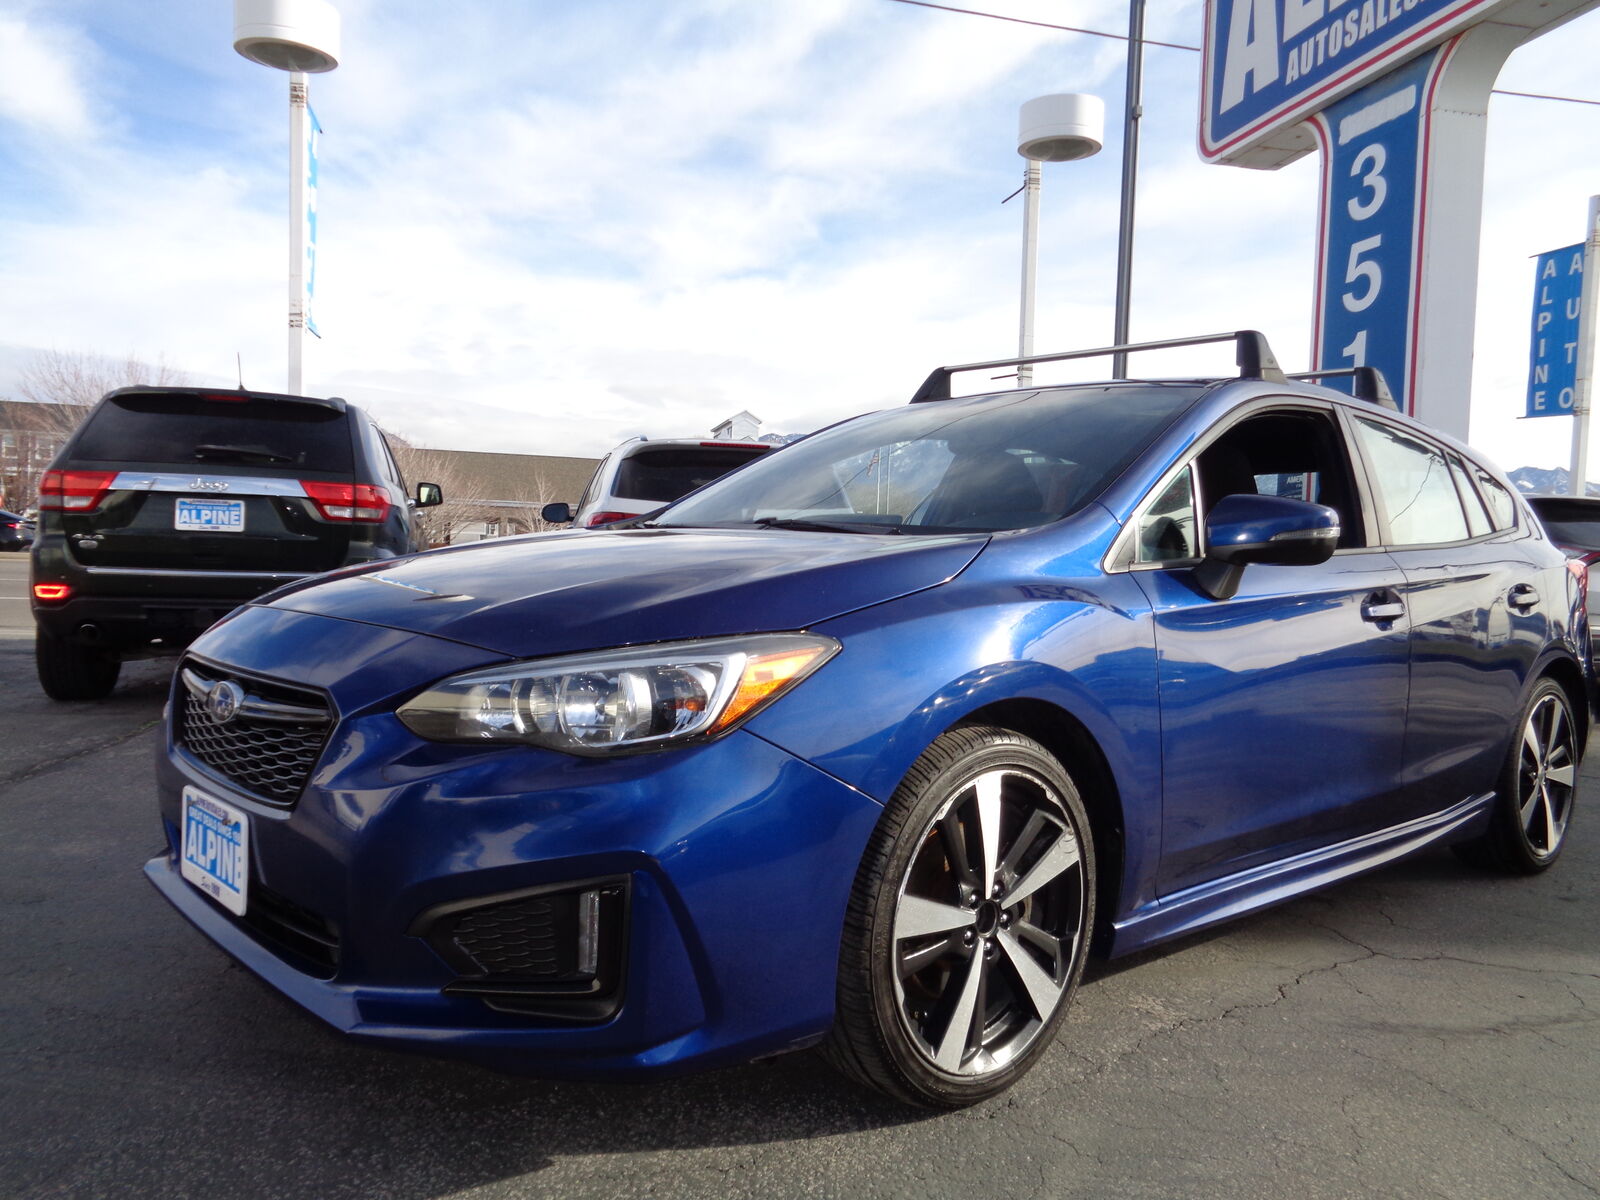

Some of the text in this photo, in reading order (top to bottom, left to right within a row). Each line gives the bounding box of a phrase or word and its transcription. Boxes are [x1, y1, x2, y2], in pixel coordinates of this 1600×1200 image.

[1286, 0, 1418, 86] AUTOSALE
[1534, 258, 1557, 411] ALPINE
[1558, 252, 1584, 409] AUTO
[179, 508, 240, 525] ALPINE
[189, 478, 229, 491] Jeep
[187, 820, 241, 889] ALPINE
